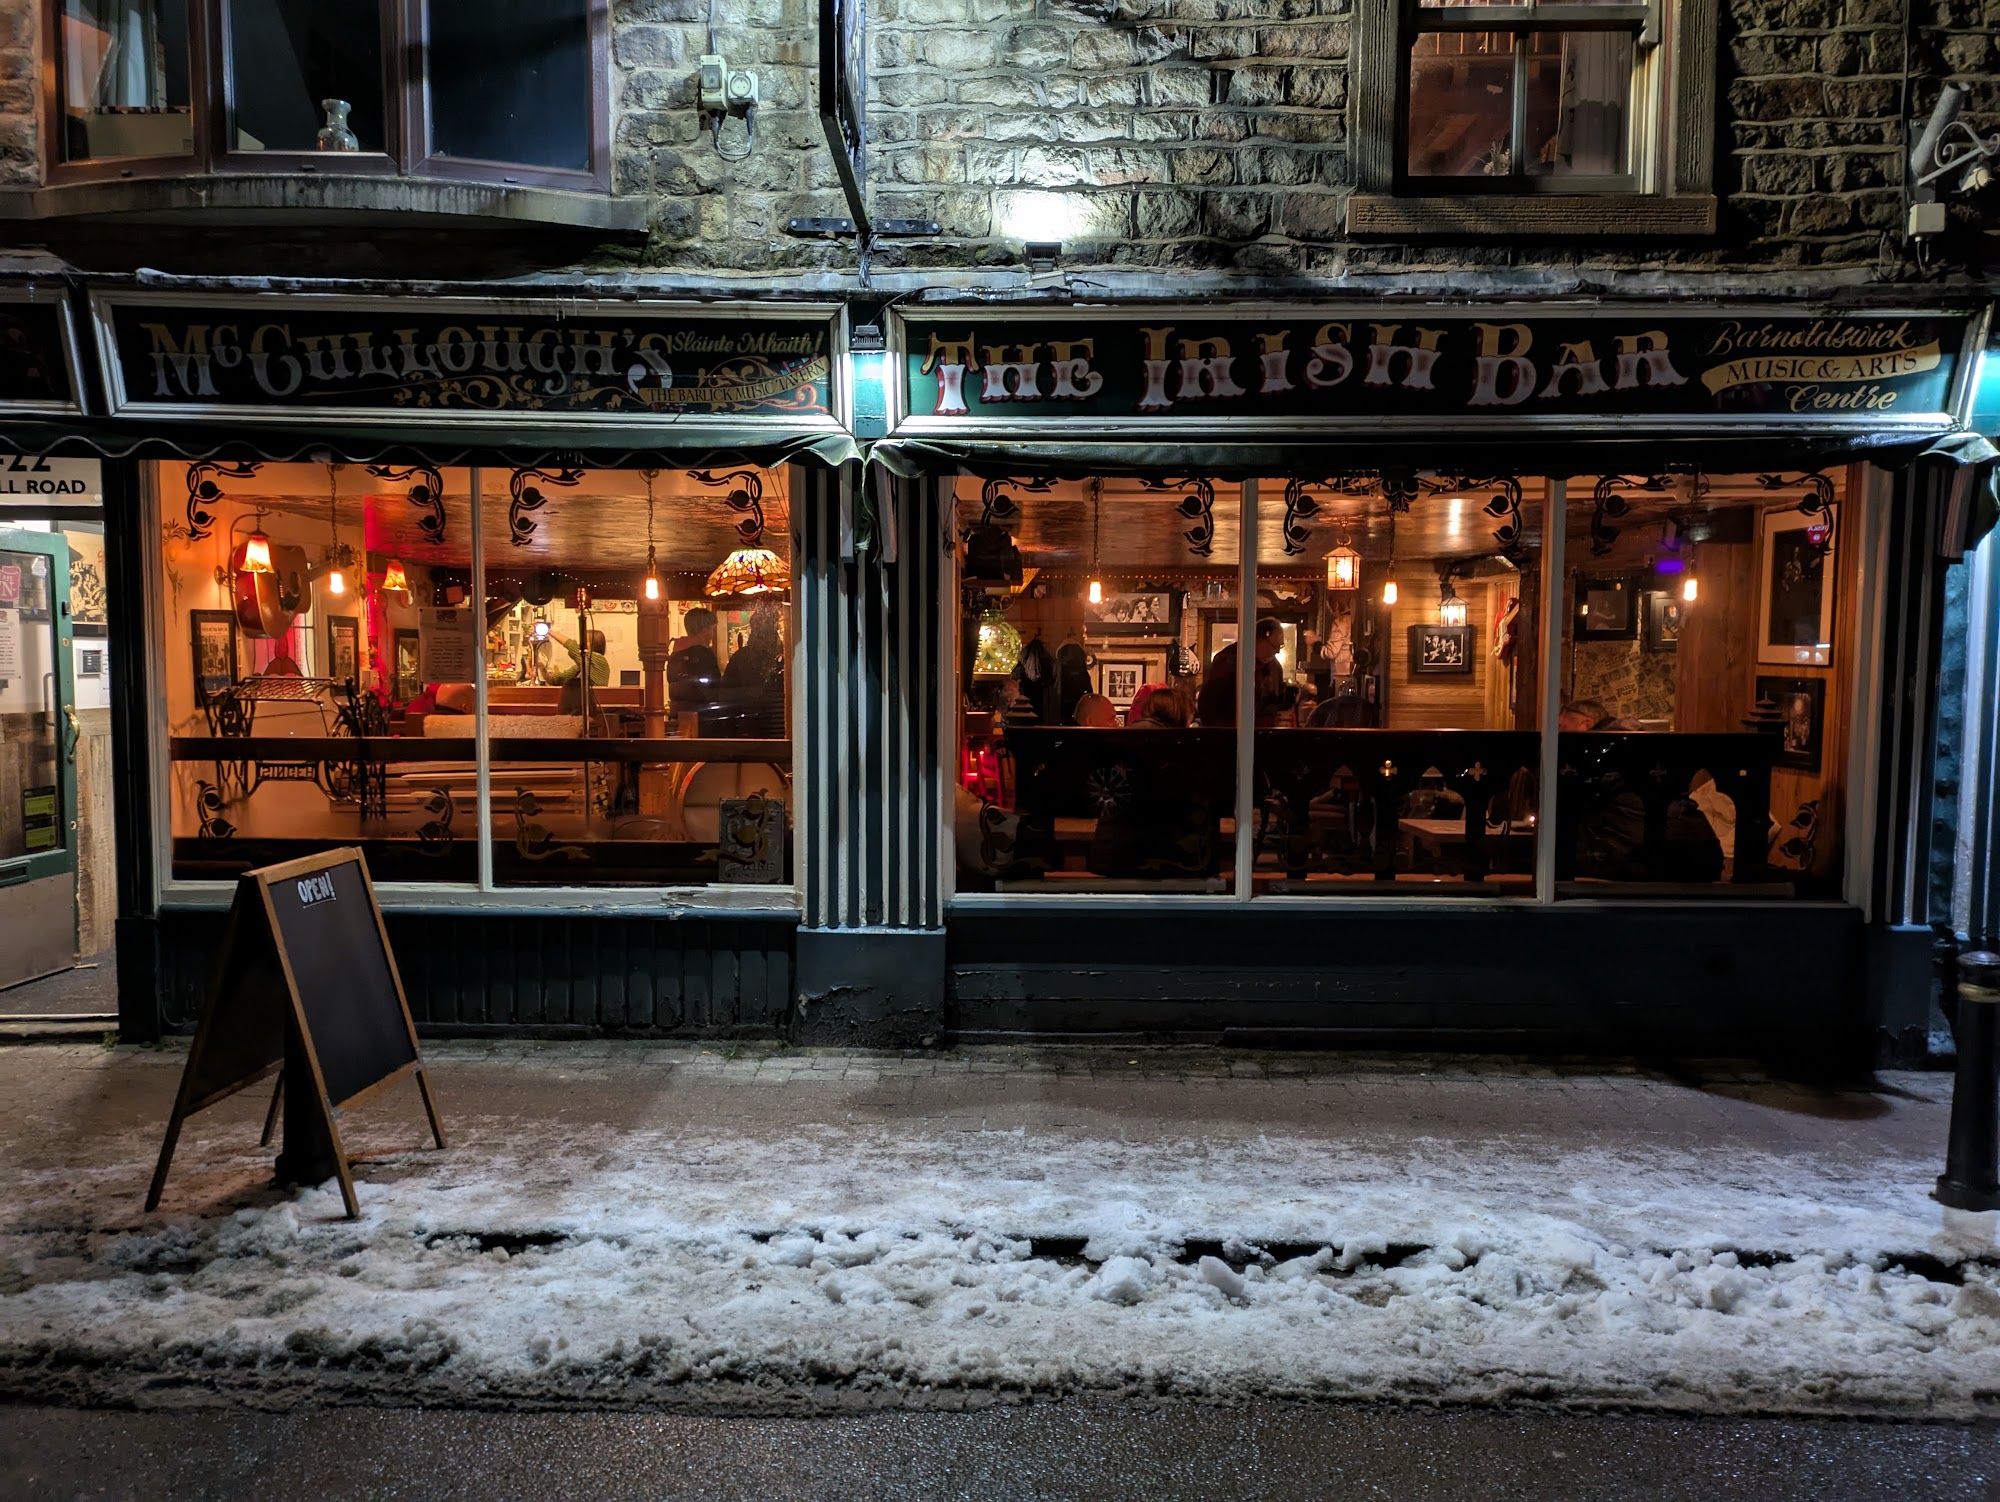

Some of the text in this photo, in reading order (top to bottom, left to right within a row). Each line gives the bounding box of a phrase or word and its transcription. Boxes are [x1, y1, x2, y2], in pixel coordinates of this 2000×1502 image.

[736, 330, 825, 356] Mhaith!
[1705, 320, 1916, 356] Barnoldswick
[920, 321, 1688, 416] THE IRISH BAR
[1848, 351, 1918, 378] ARTS
[647, 359, 826, 402] THE BARLICK MUSIC TAVERN
[1784, 384, 1898, 413] Centre
[27, 480, 86, 494] ROAD
[297, 871, 336, 903] OPEN!
